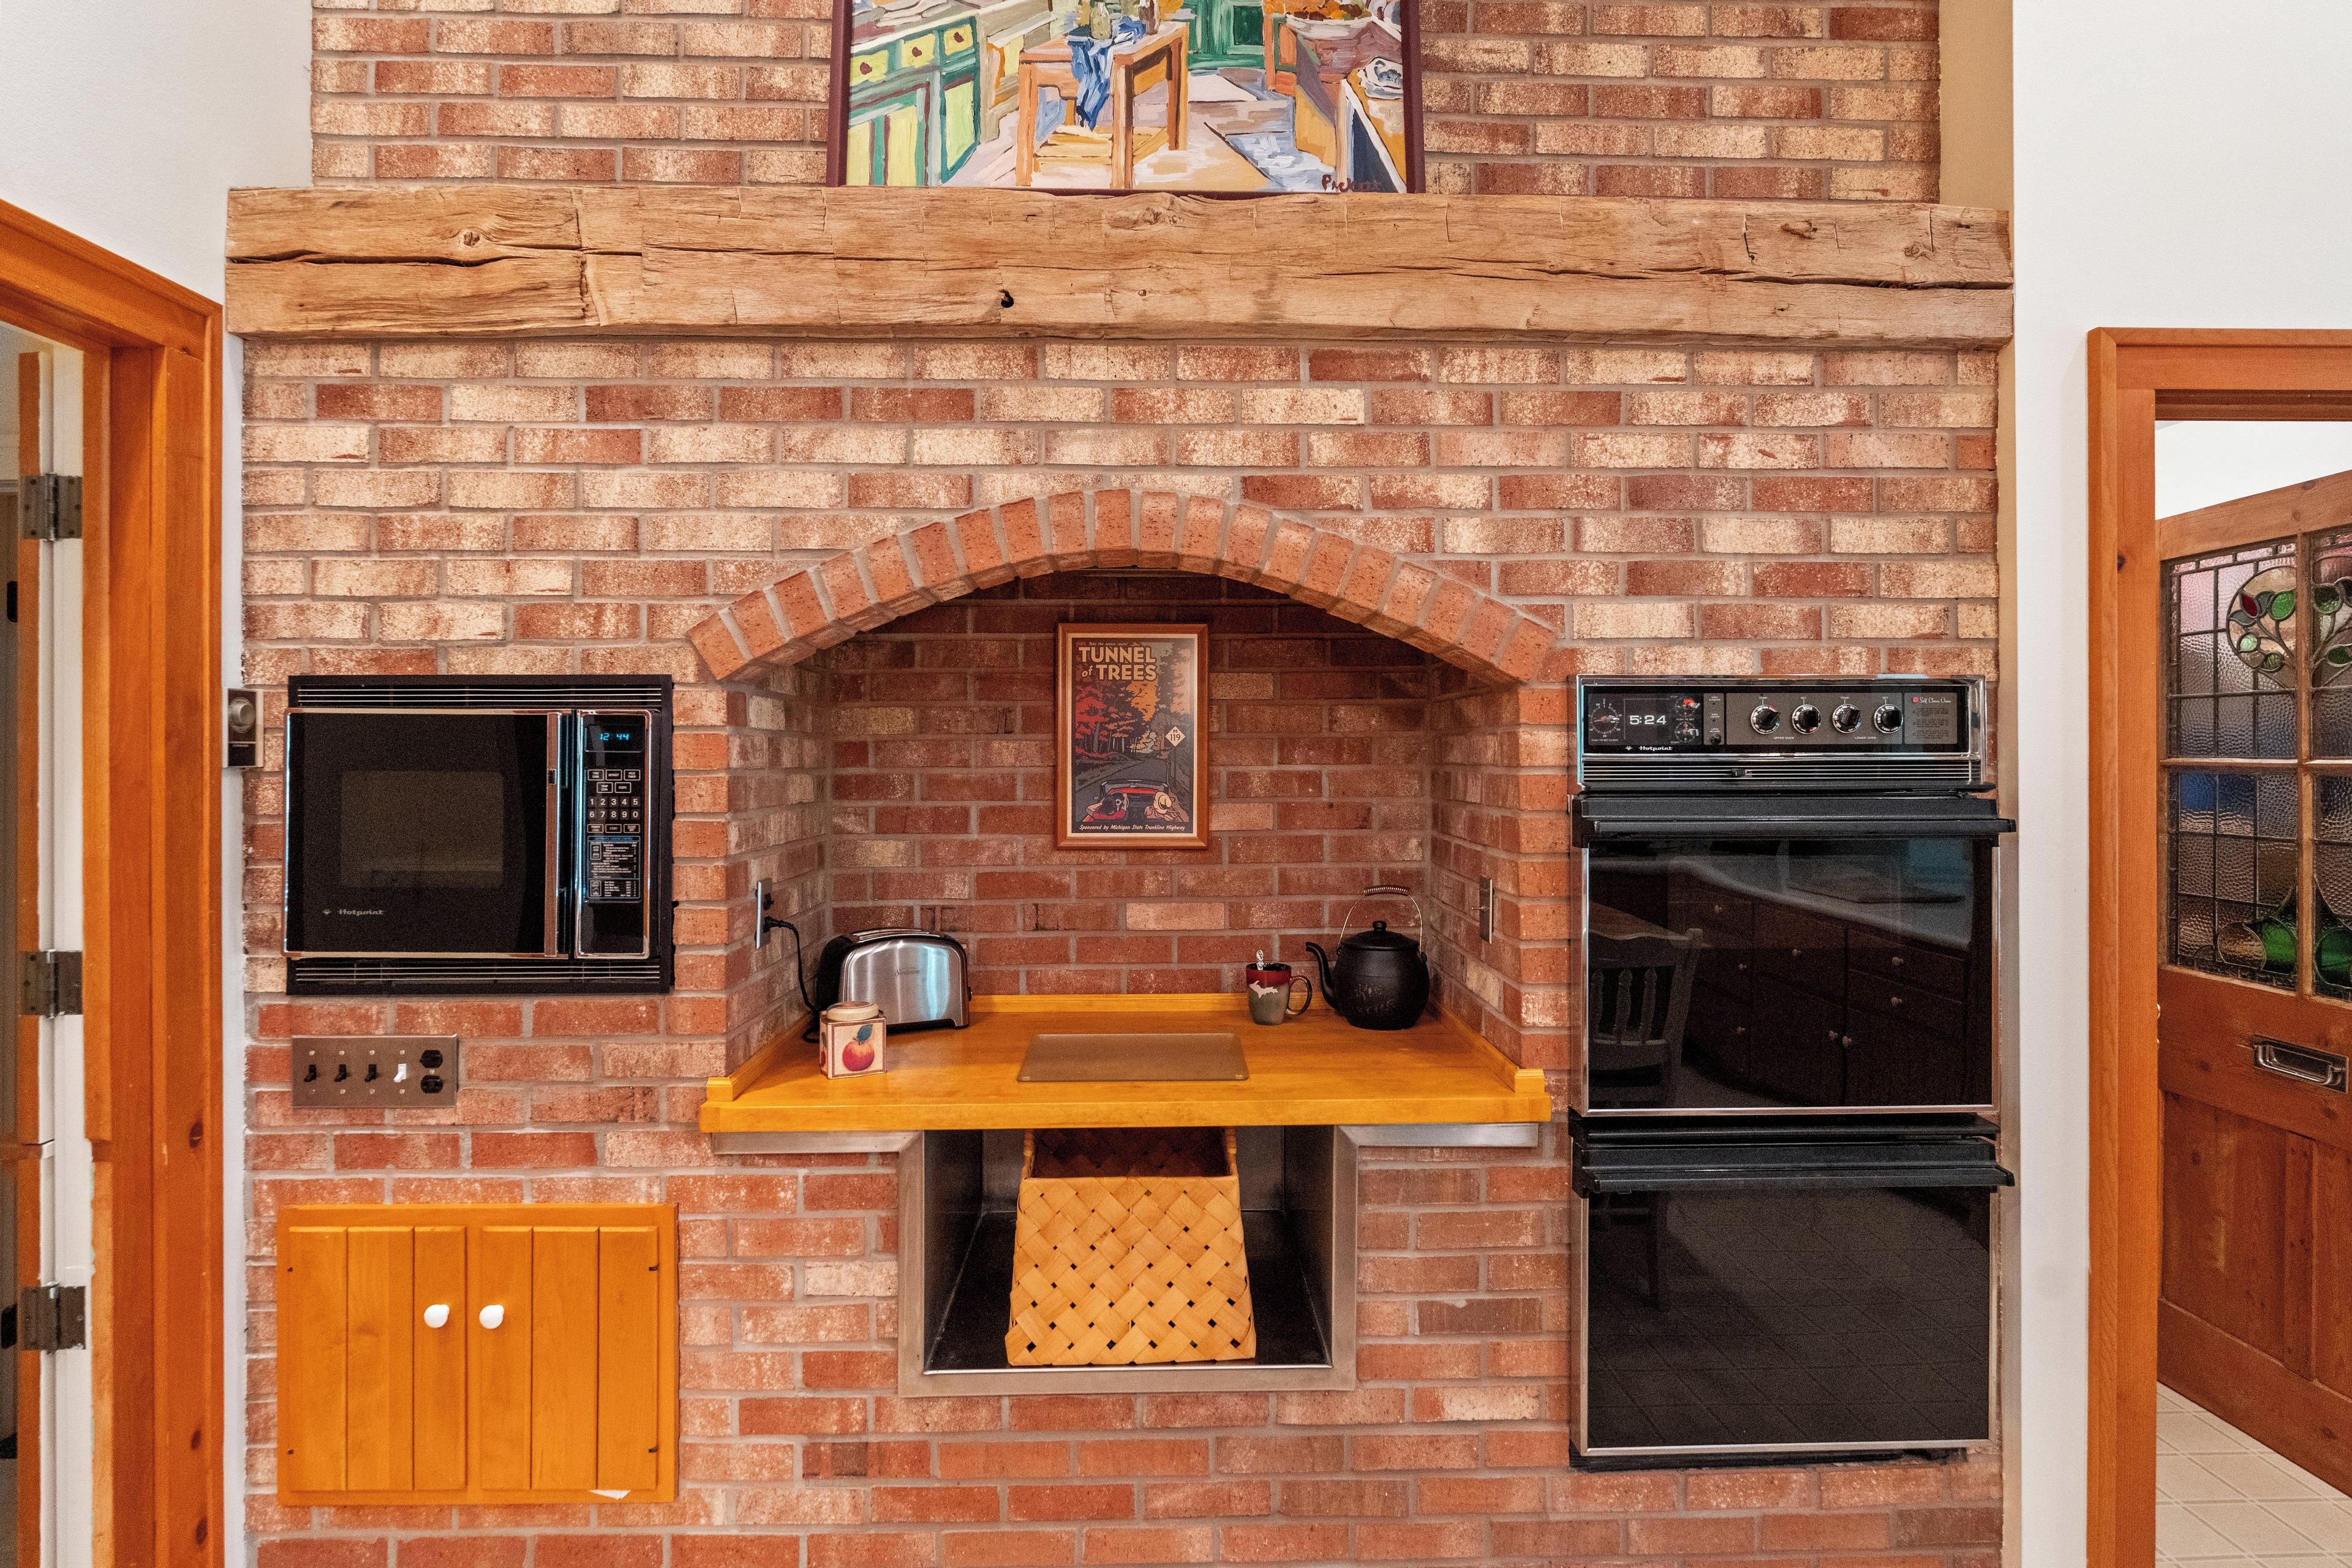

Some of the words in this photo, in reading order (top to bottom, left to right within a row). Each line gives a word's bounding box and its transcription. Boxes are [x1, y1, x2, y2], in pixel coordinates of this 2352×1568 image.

[1079, 647, 1156, 663] TUNNEL
[1082, 665, 1093, 677] of
[1096, 664, 1157, 680] TREES
[1629, 715, 1666, 725] 5:24
